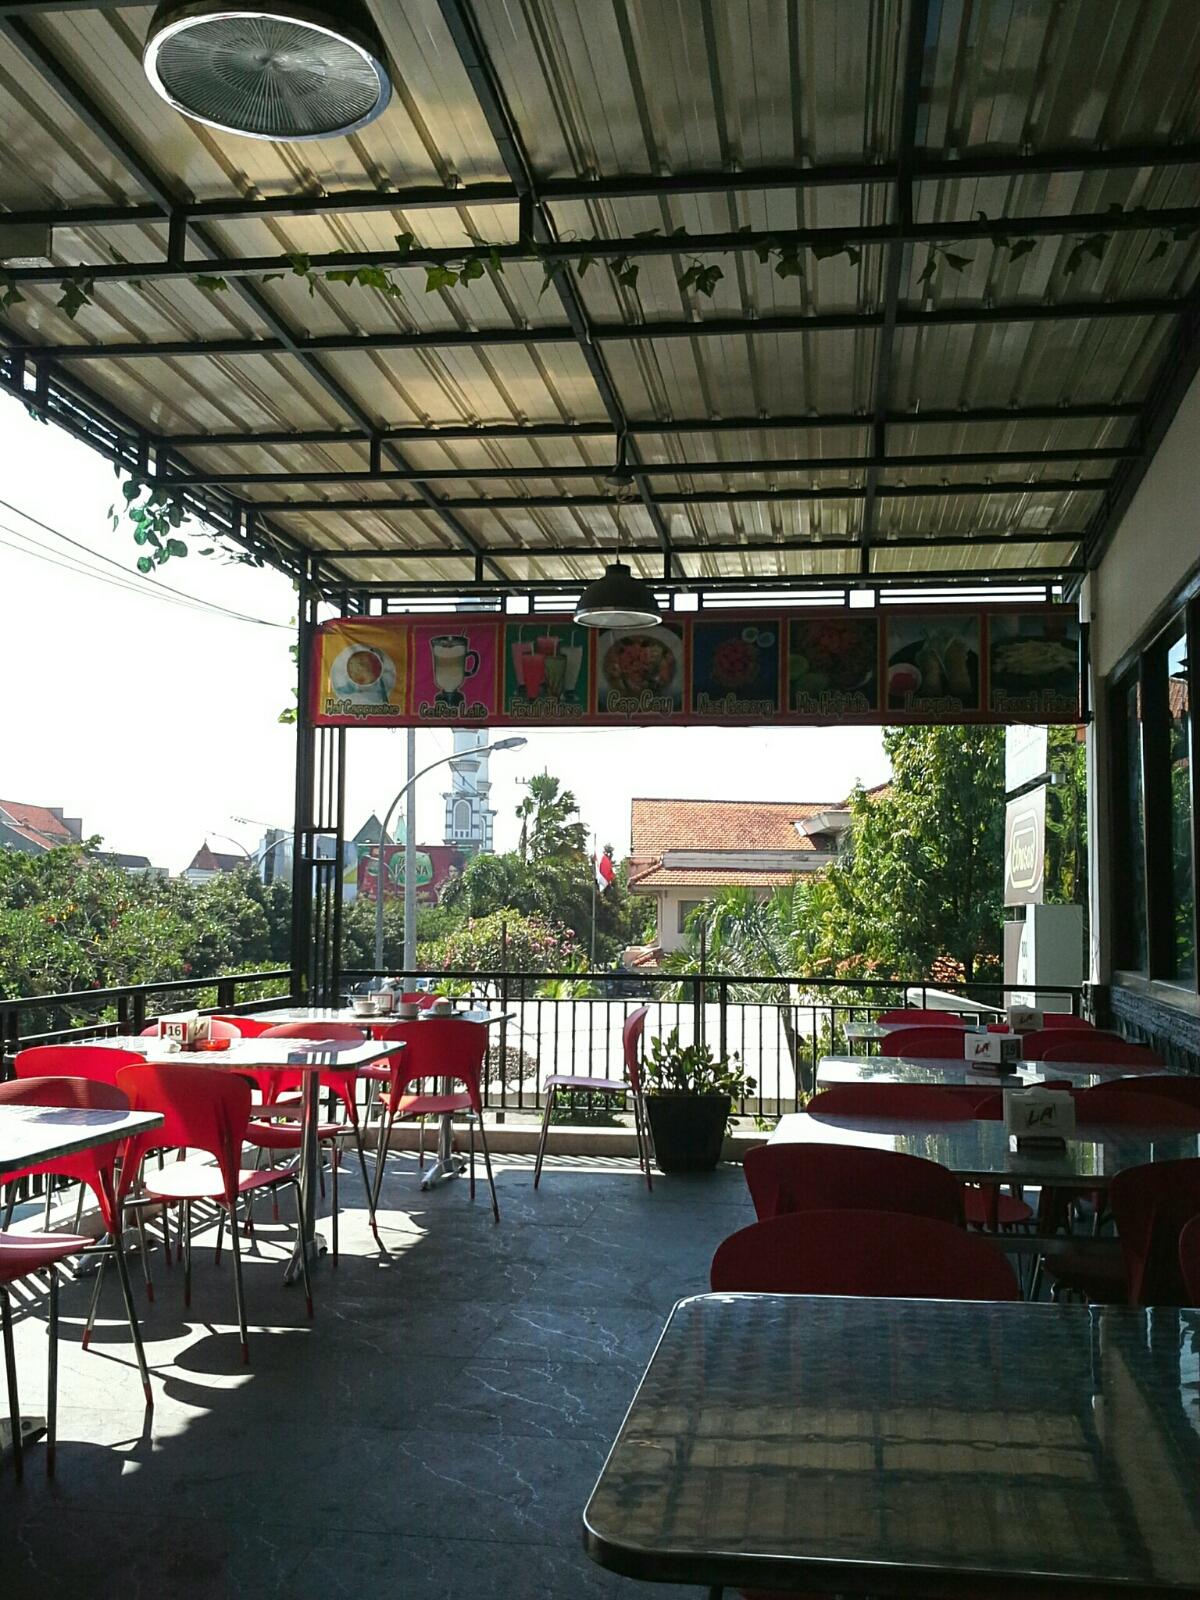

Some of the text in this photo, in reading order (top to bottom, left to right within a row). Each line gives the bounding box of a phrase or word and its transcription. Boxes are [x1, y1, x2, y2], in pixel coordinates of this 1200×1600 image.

[325, 699, 345, 715] Hot
[419, 702, 488, 718] Coffee Latte
[607, 690, 673, 720] Cap Cay
[697, 692, 774, 719] Nasi Goreng
[168, 1025, 181, 1036] 16
[1028, 1106, 1053, 1126] LA
